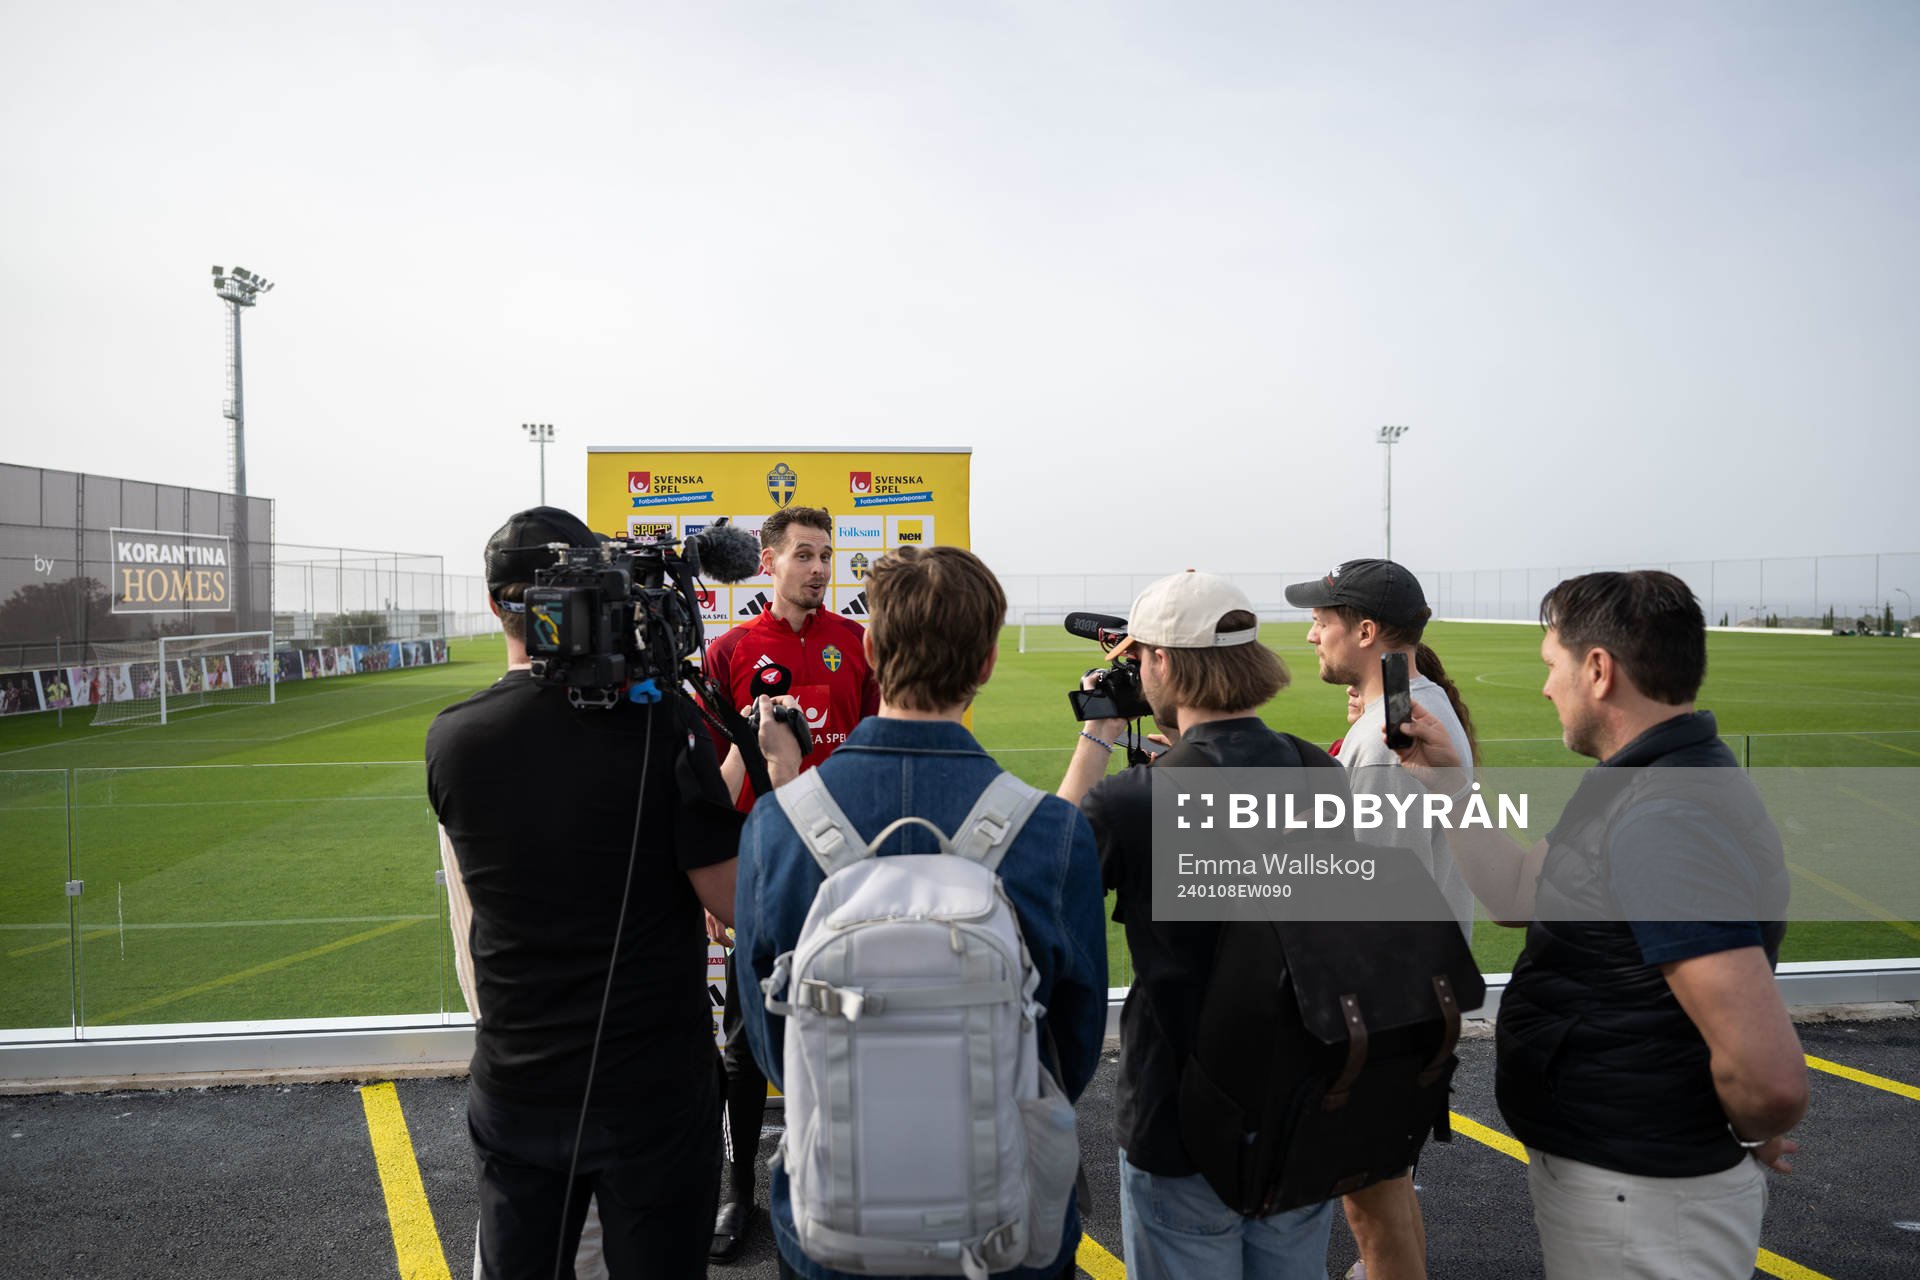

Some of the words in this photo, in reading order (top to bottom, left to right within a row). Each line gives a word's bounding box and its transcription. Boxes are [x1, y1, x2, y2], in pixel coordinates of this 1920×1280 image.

[654, 475, 704, 484] SVENSKA
[875, 475, 924, 484] SVENSKA
[654, 485, 680, 493] SPEL
[875, 485, 900, 493] SPEL
[839, 527, 880, 537] Folksam
[118, 542, 226, 566] KORANTINA
[34, 554, 55, 576] by
[122, 568, 225, 602] HOMES
